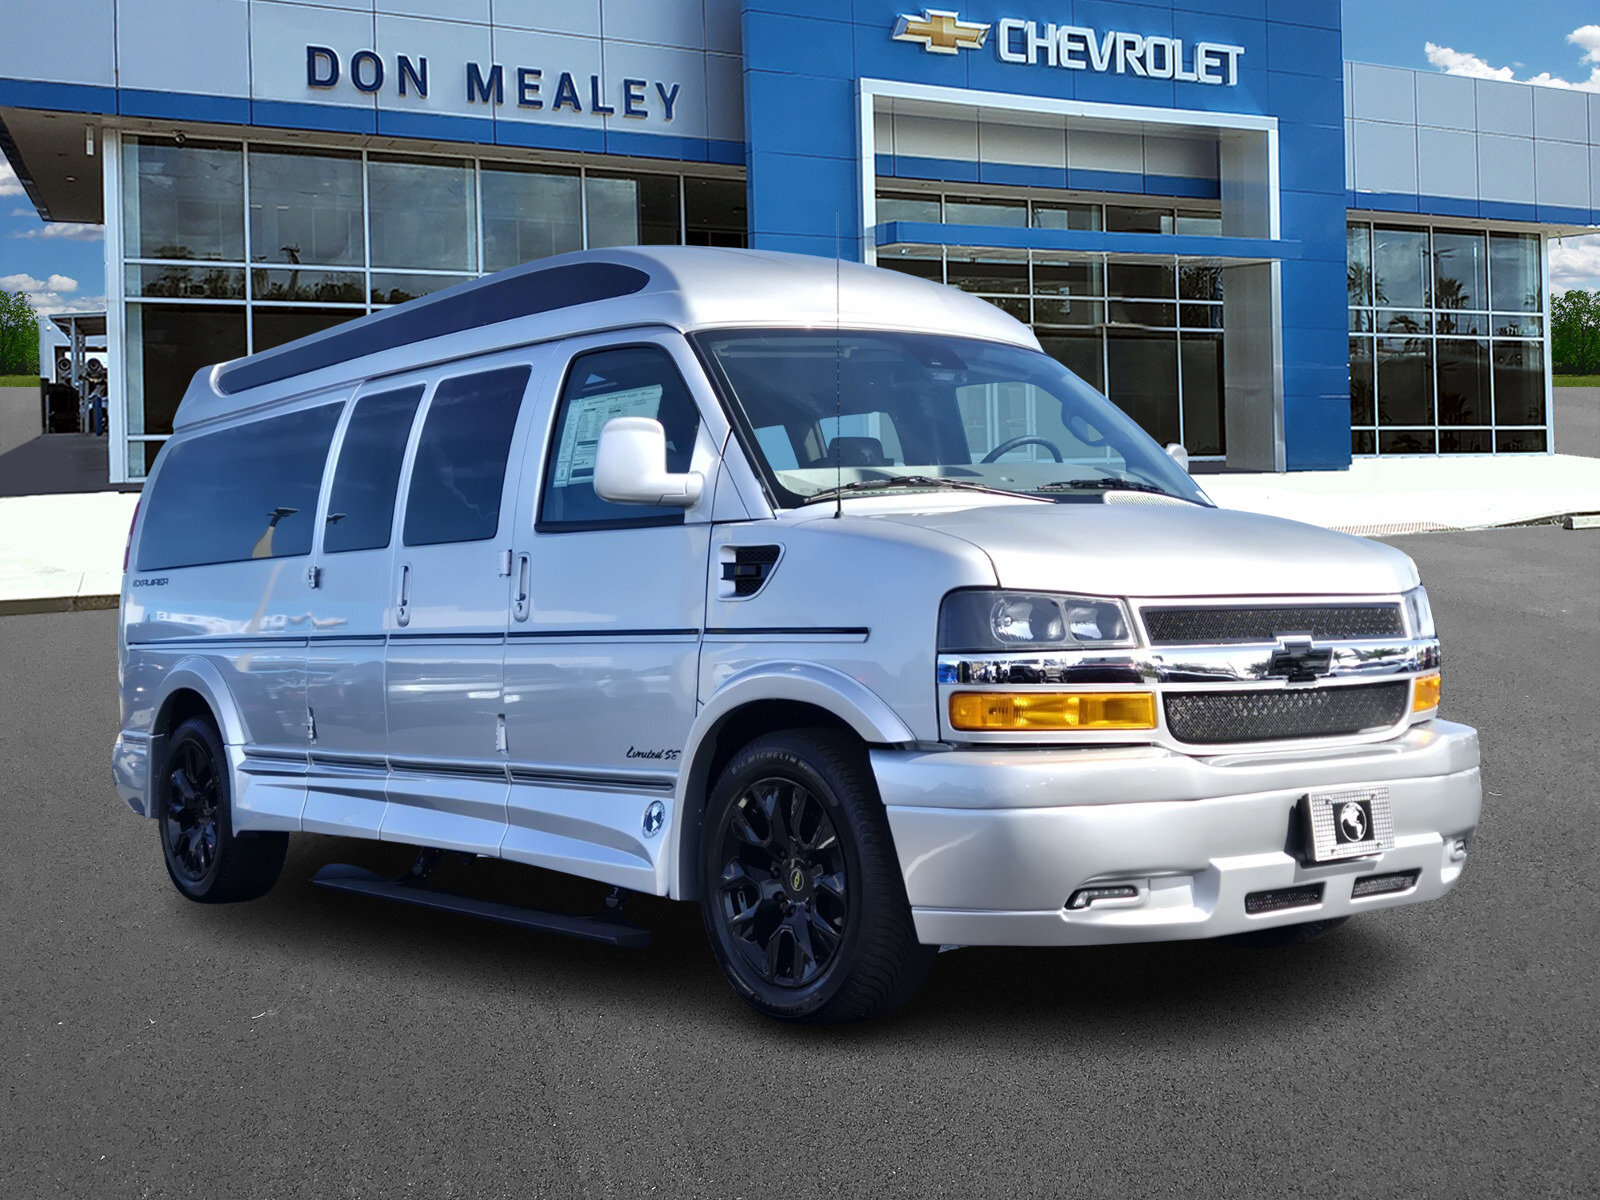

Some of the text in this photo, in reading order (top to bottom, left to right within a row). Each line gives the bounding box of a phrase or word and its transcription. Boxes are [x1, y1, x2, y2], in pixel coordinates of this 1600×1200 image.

[998, 17, 1246, 87] CHEVROLET
[306, 45, 681, 122] DON MEALEY
[626, 746, 664, 759] Limited
[748, 751, 797, 764] MICHELIN
